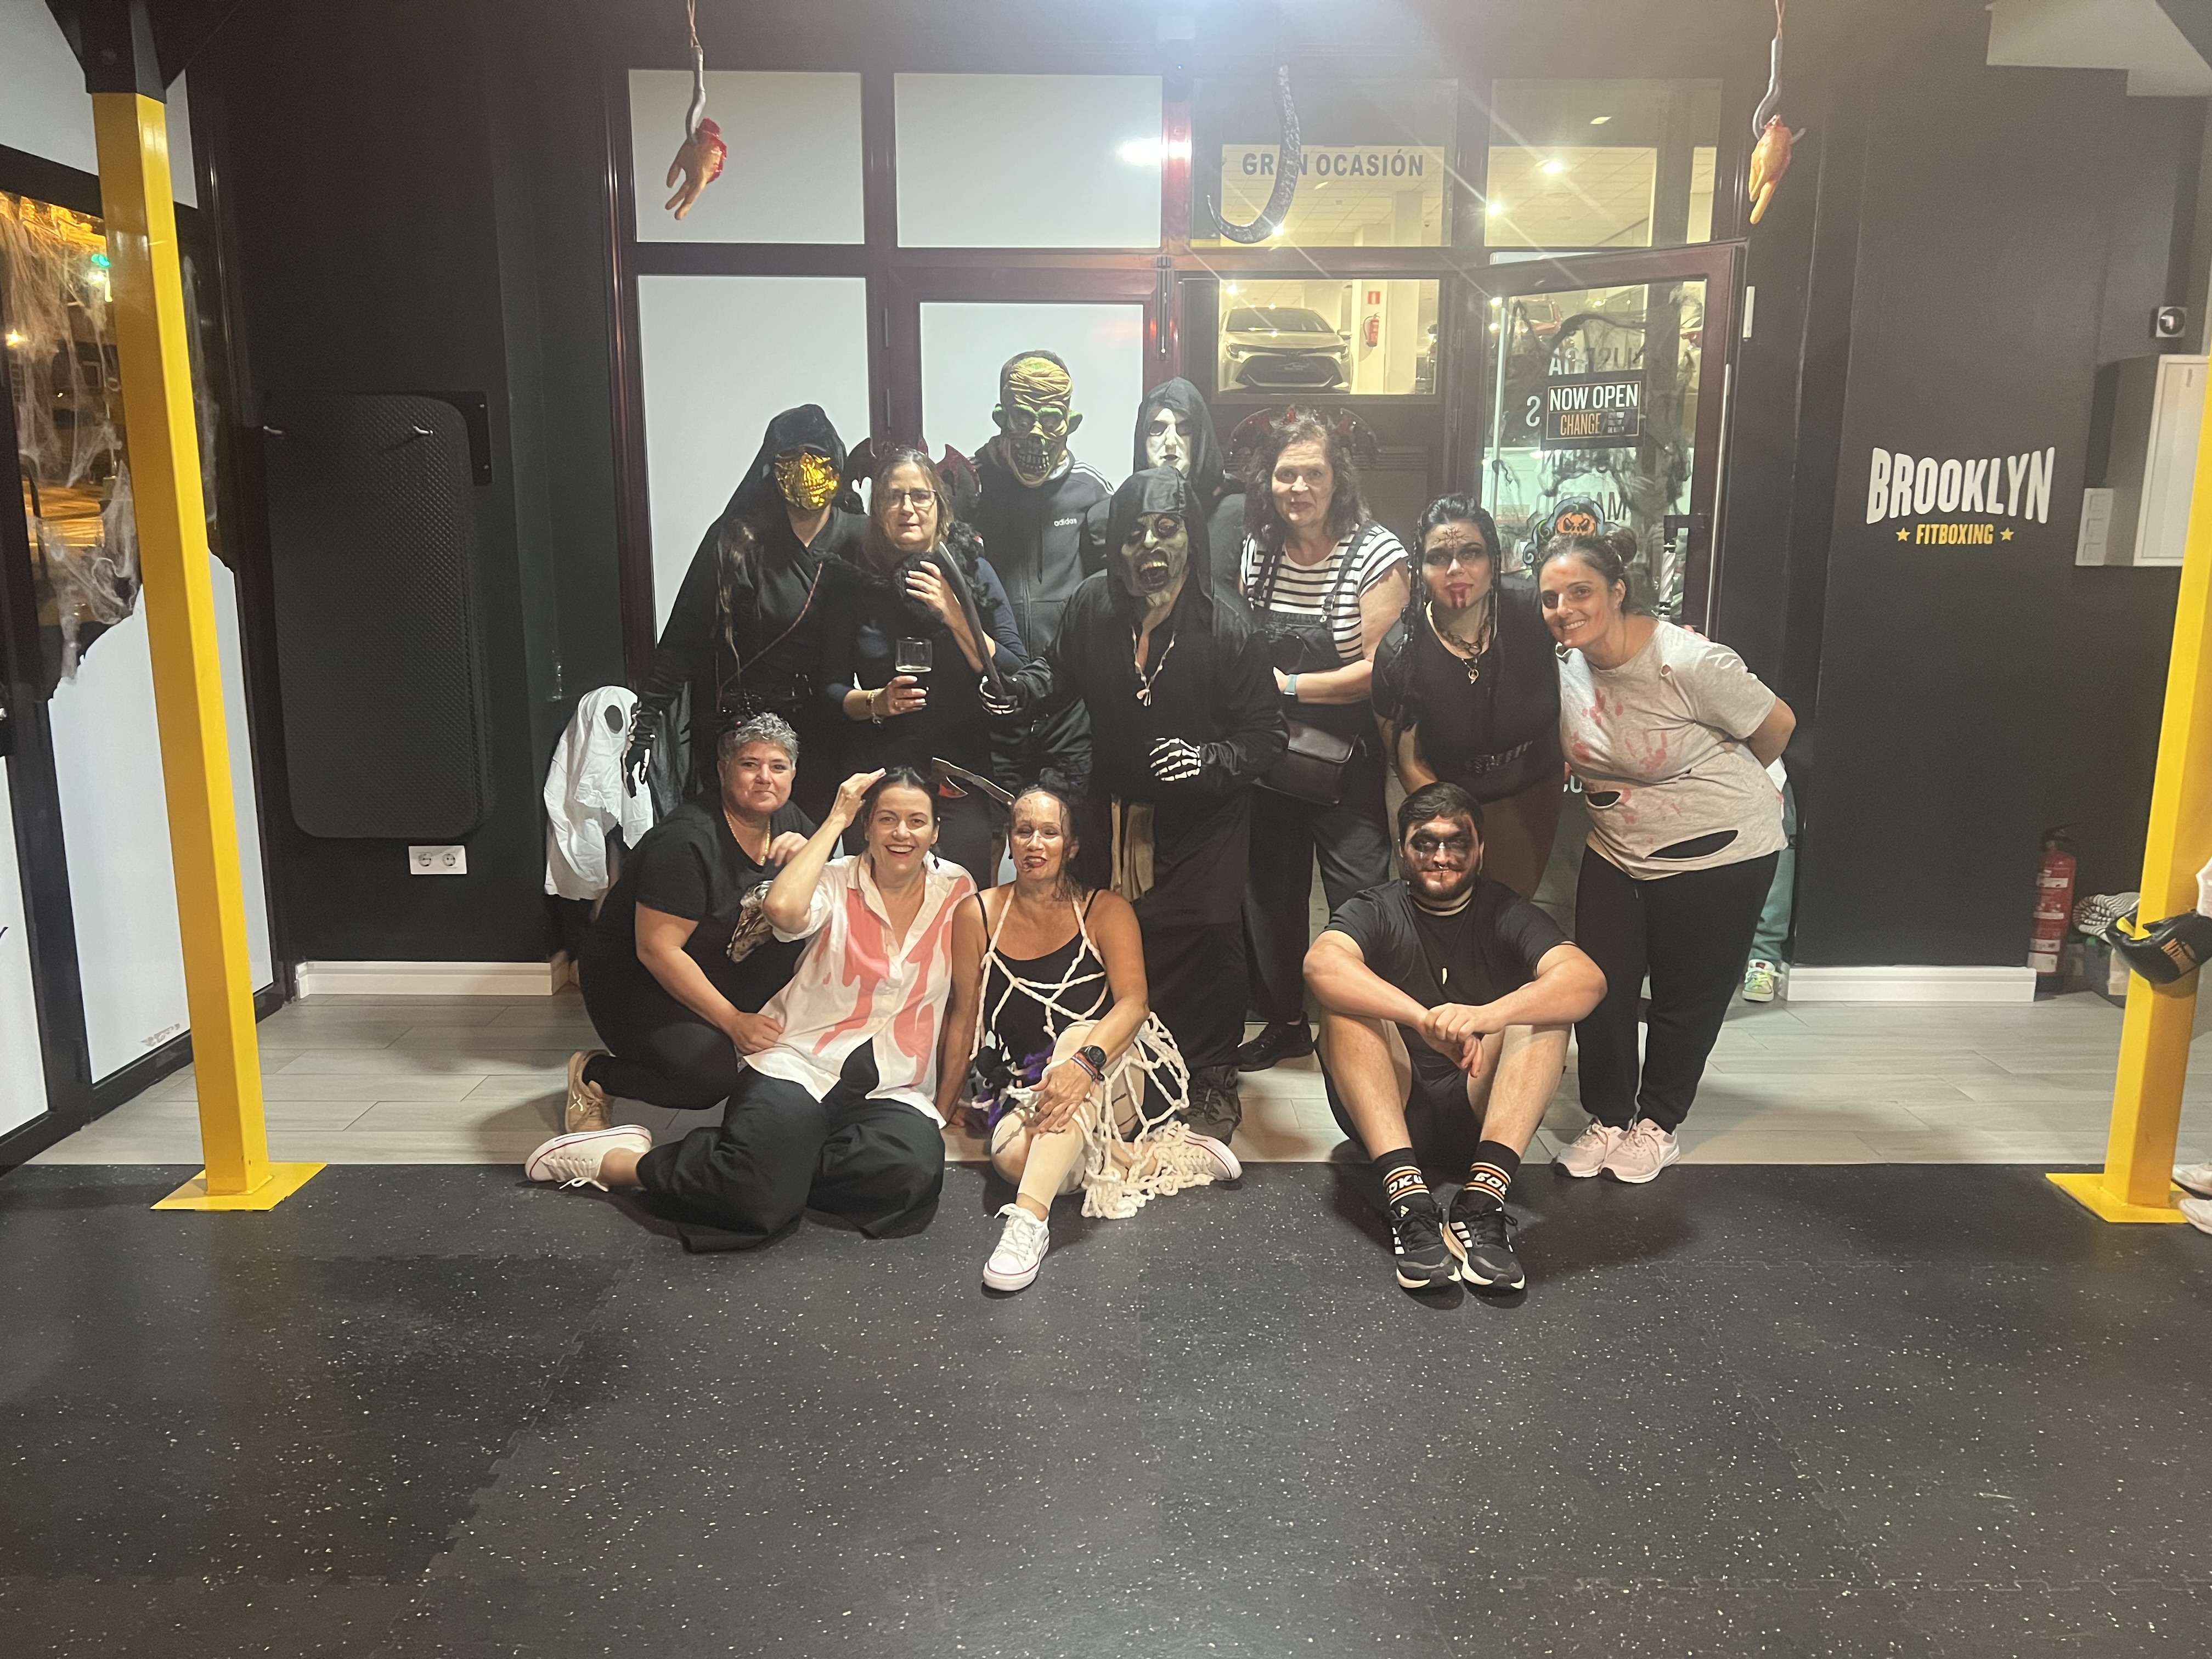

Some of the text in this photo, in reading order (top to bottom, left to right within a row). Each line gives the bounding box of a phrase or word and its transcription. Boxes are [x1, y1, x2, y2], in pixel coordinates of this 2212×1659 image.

[1242, 149, 1423, 176] GRN OCASIÓN
[1550, 387, 1589, 411] NOW
[1593, 383, 1638, 409] OPEN
[1560, 413, 1601, 436] CHANGE
[1866, 447, 2055, 524] BROOKLYN
[1054, 517, 1077, 527] adidas
[1916, 524, 1993, 544] FITBOXING
[1387, 1175, 1424, 1195] OKU
[1474, 1172, 1508, 1196] GOK
